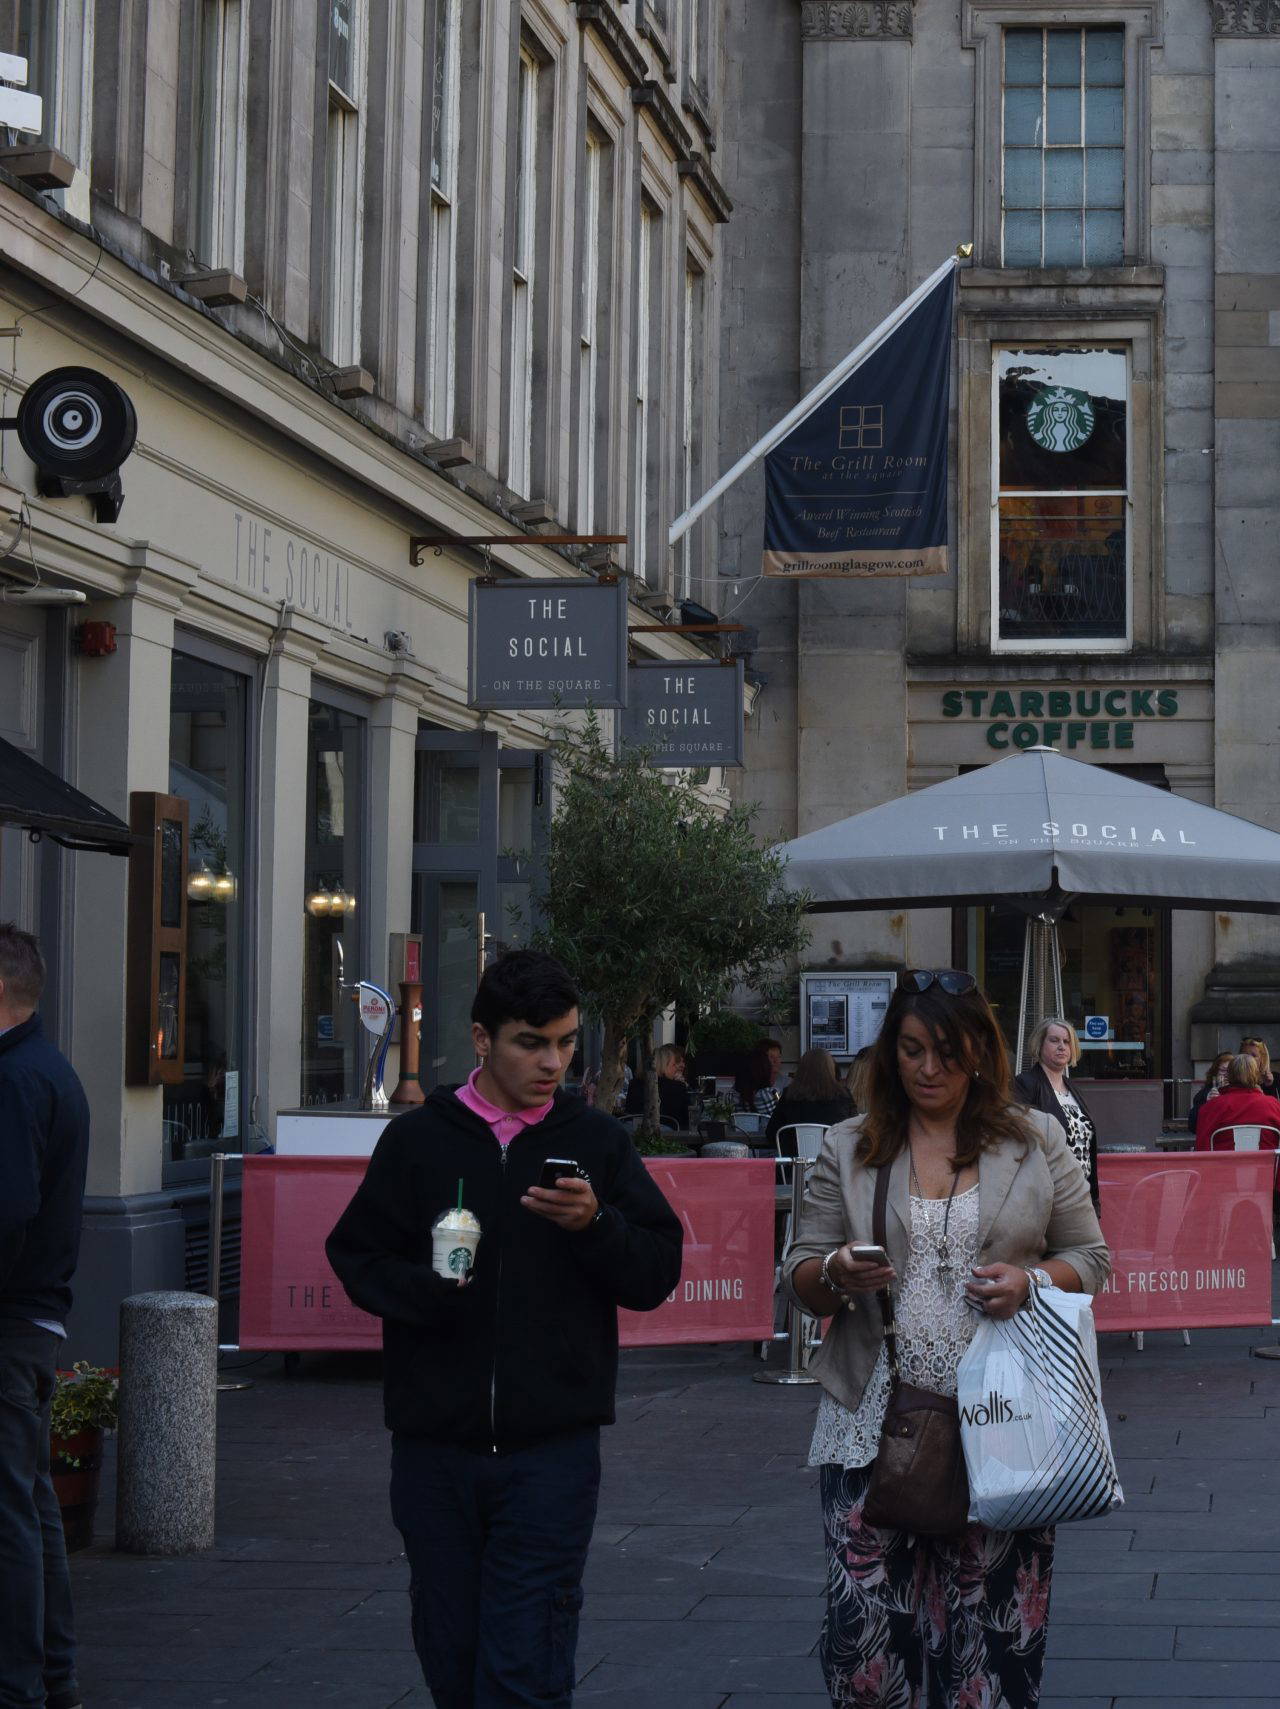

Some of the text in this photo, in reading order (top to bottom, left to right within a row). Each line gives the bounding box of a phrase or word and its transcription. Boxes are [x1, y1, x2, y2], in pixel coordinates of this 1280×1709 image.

[790, 455, 928, 471] The Grill Room
[817, 527, 841, 542] Beef
[234, 512, 352, 628] THE SOCIAL
[782, 557, 924, 574] grillroomglasgow.com
[528, 599, 567, 619] THE
[509, 637, 587, 657] SOCIAL
[493, 680, 601, 692] ON THE SQUARE
[663, 677, 696, 694] THE
[942, 689, 1179, 718] STARBUCKS
[647, 708, 712, 725] SOCIAL
[986, 722, 1135, 749] COFFEE
[679, 743, 723, 753] SQUARE
[932, 821, 1197, 845] THE SOCIAL
[684, 1278, 743, 1303] DINING
[1128, 1270, 1188, 1293] FRESCO
[1195, 1268, 1246, 1290] DINING
[288, 1286, 331, 1308] THE
